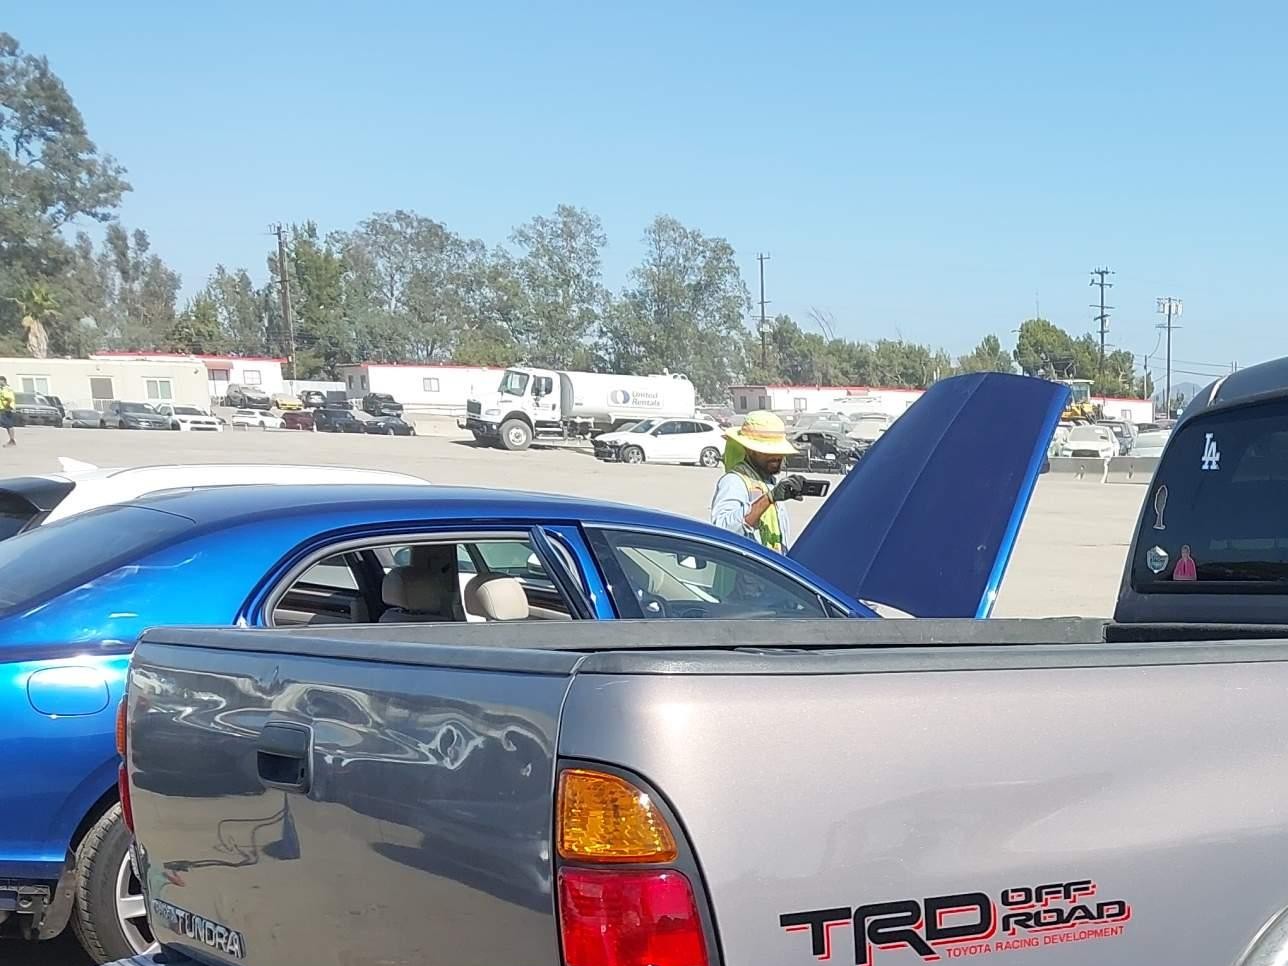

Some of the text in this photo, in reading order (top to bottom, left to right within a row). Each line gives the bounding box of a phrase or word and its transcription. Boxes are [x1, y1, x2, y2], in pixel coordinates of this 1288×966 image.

[631, 391, 659, 399] United
[631, 398, 661, 407] Rentals
[1201, 432, 1221, 470] LA
[1001, 880, 1096, 911] OFF
[176, 908, 246, 960] TUNDRA
[1002, 900, 1131, 936] ROAD
[946, 925, 1125, 958] TOYOTA RACING DEVELOPMENT
